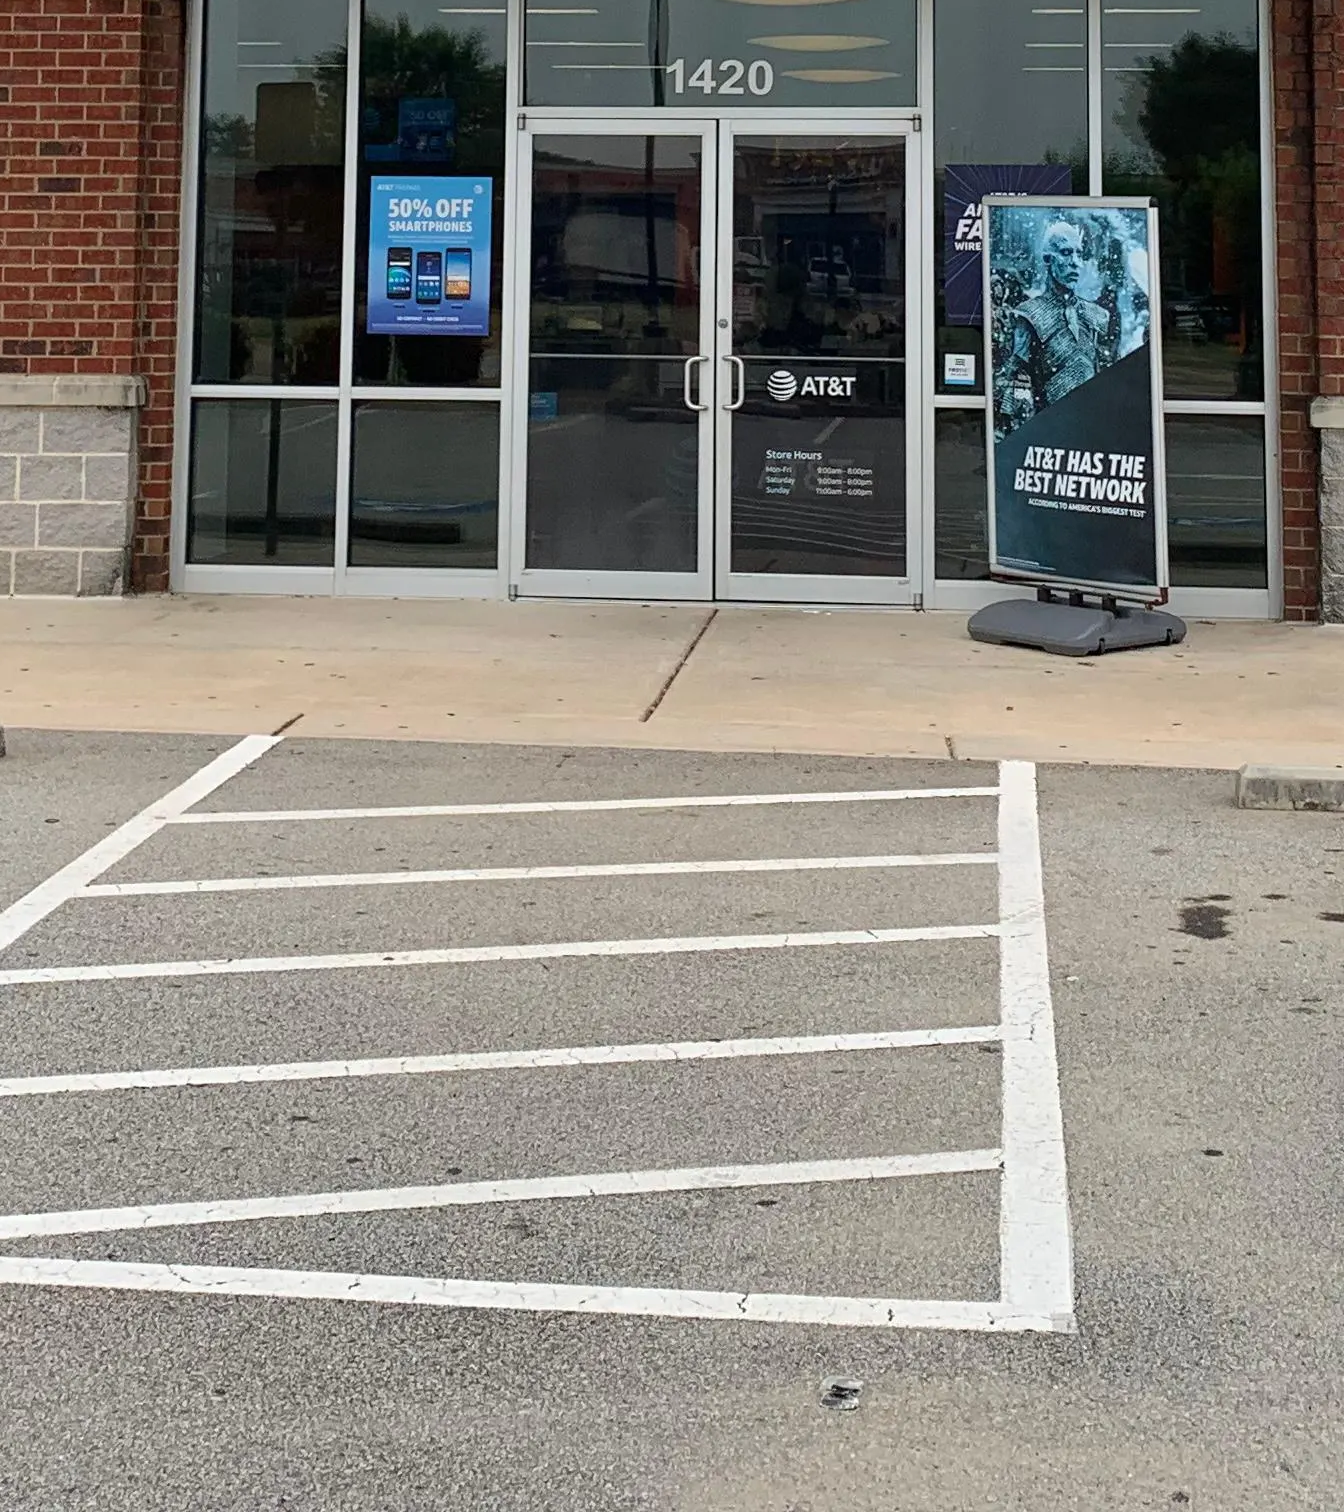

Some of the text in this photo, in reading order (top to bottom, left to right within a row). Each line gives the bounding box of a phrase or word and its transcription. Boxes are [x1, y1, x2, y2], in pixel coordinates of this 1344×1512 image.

[666, 58, 774, 96] 1420
[388, 198, 474, 219] 50% OFF
[389, 220, 473, 233] SMARTPHONES
[800, 376, 856, 396] AT&T
[765, 449, 823, 461] Store Hours
[1023, 446, 1146, 479] AT&T HAS THE
[765, 465, 792, 473] Mon-Fri
[765, 475, 795, 486] Saturday
[1014, 468, 1147, 505] BEST NETWORK
[765, 486, 791, 496] Sunday
[1028, 497, 1058, 510] ACCORDING
[1058, 501, 1068, 511] TO
[1068, 503, 1101, 514] AMERICA'S
[1101, 506, 1129, 516] BIGGEST
